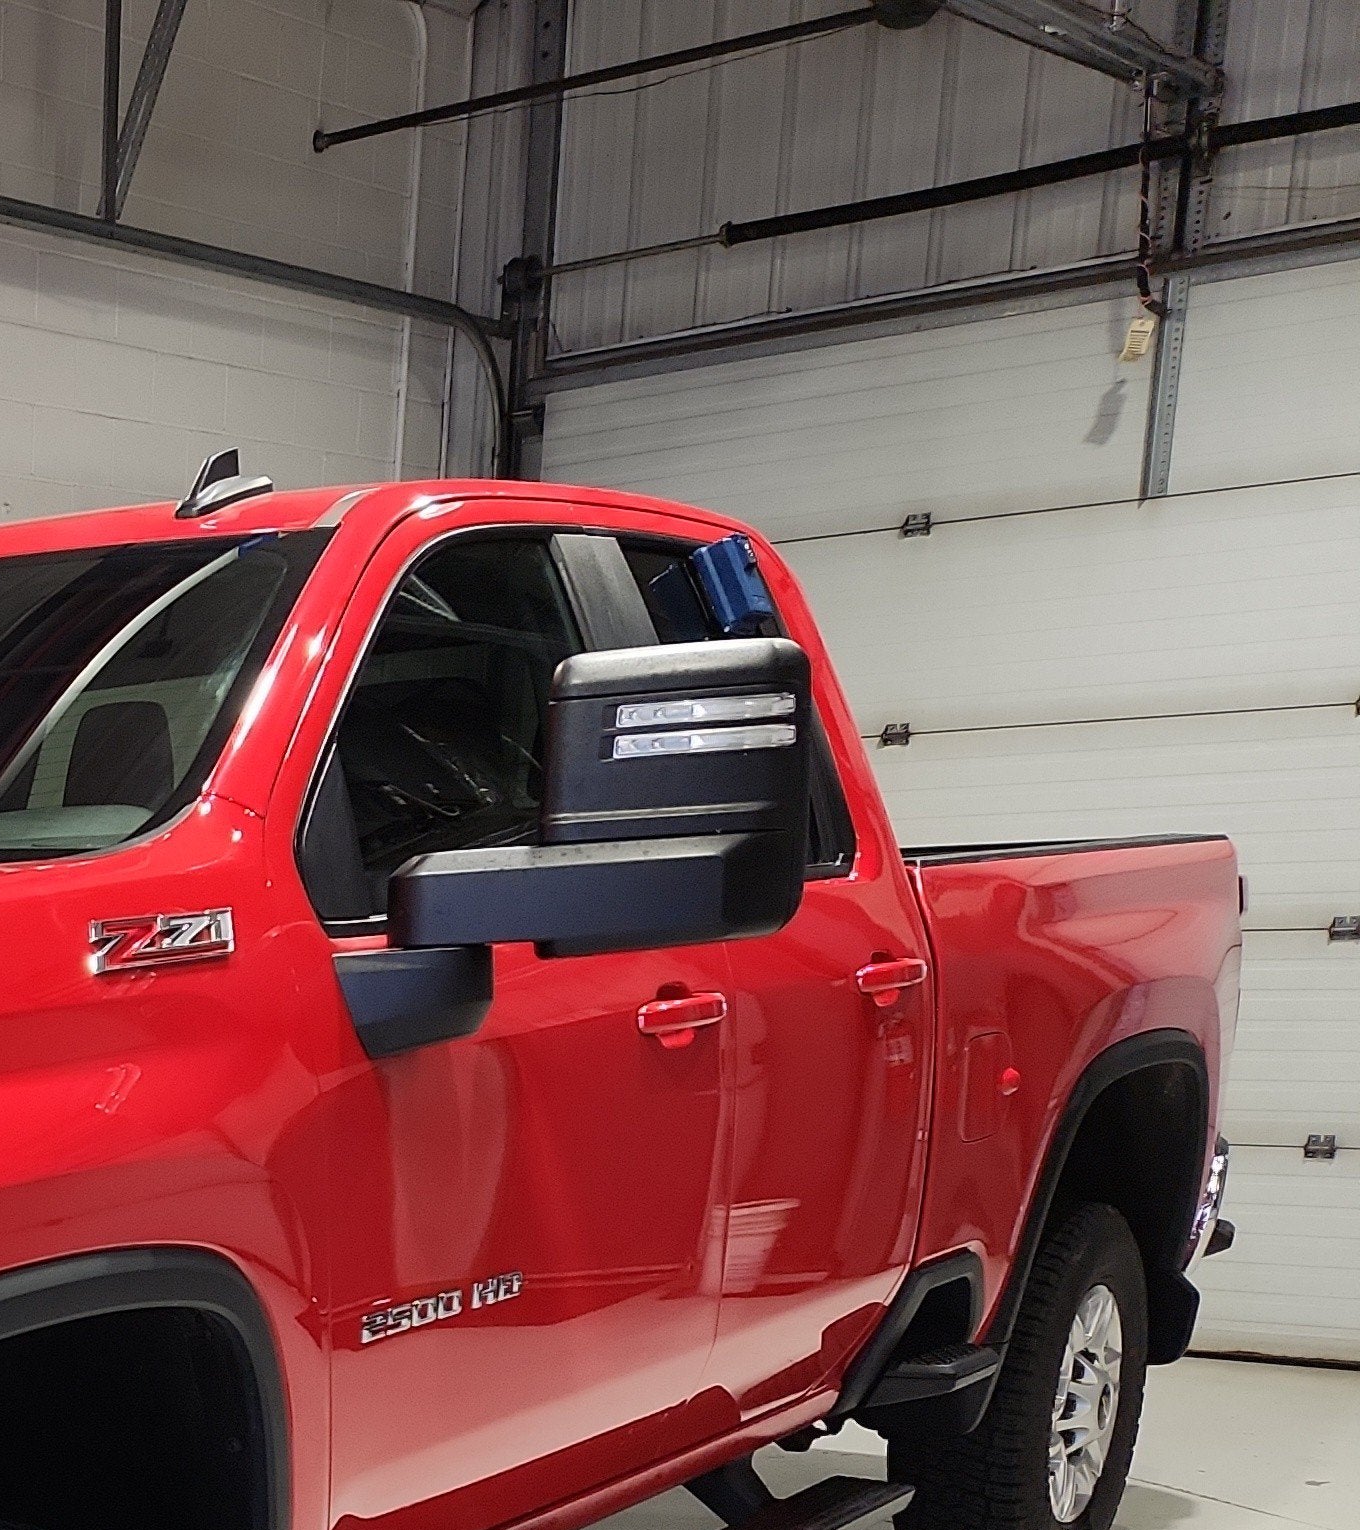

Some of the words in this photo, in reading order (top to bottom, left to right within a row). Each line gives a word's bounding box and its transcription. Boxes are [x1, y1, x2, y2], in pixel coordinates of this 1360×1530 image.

[88, 906, 234, 974] Z71
[361, 1289, 464, 1344] 2500
[470, 1270, 524, 1309] HD
